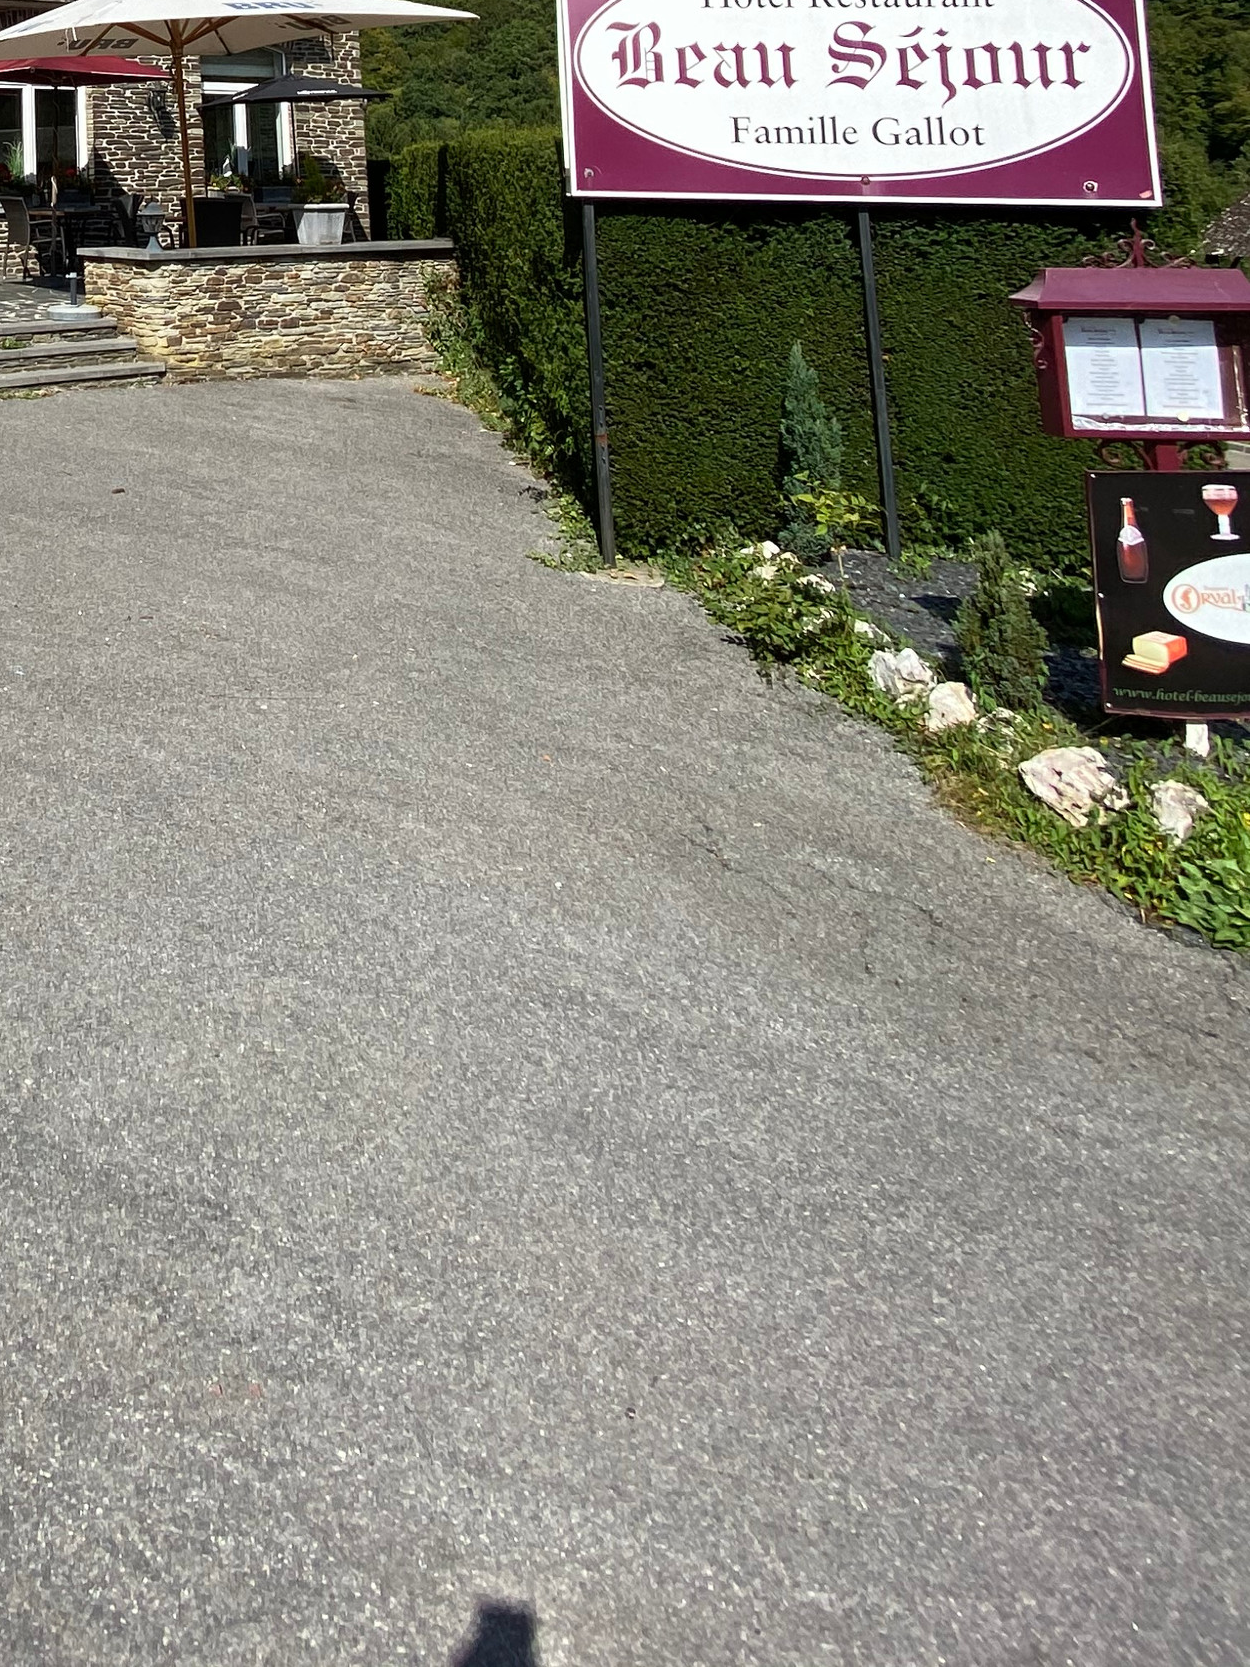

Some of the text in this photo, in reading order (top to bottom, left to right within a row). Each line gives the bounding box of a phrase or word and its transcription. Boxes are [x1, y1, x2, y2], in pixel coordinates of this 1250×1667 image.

[604, 20, 1092, 109] Beau Séjour
[729, 115, 987, 148] Famille Gallot
